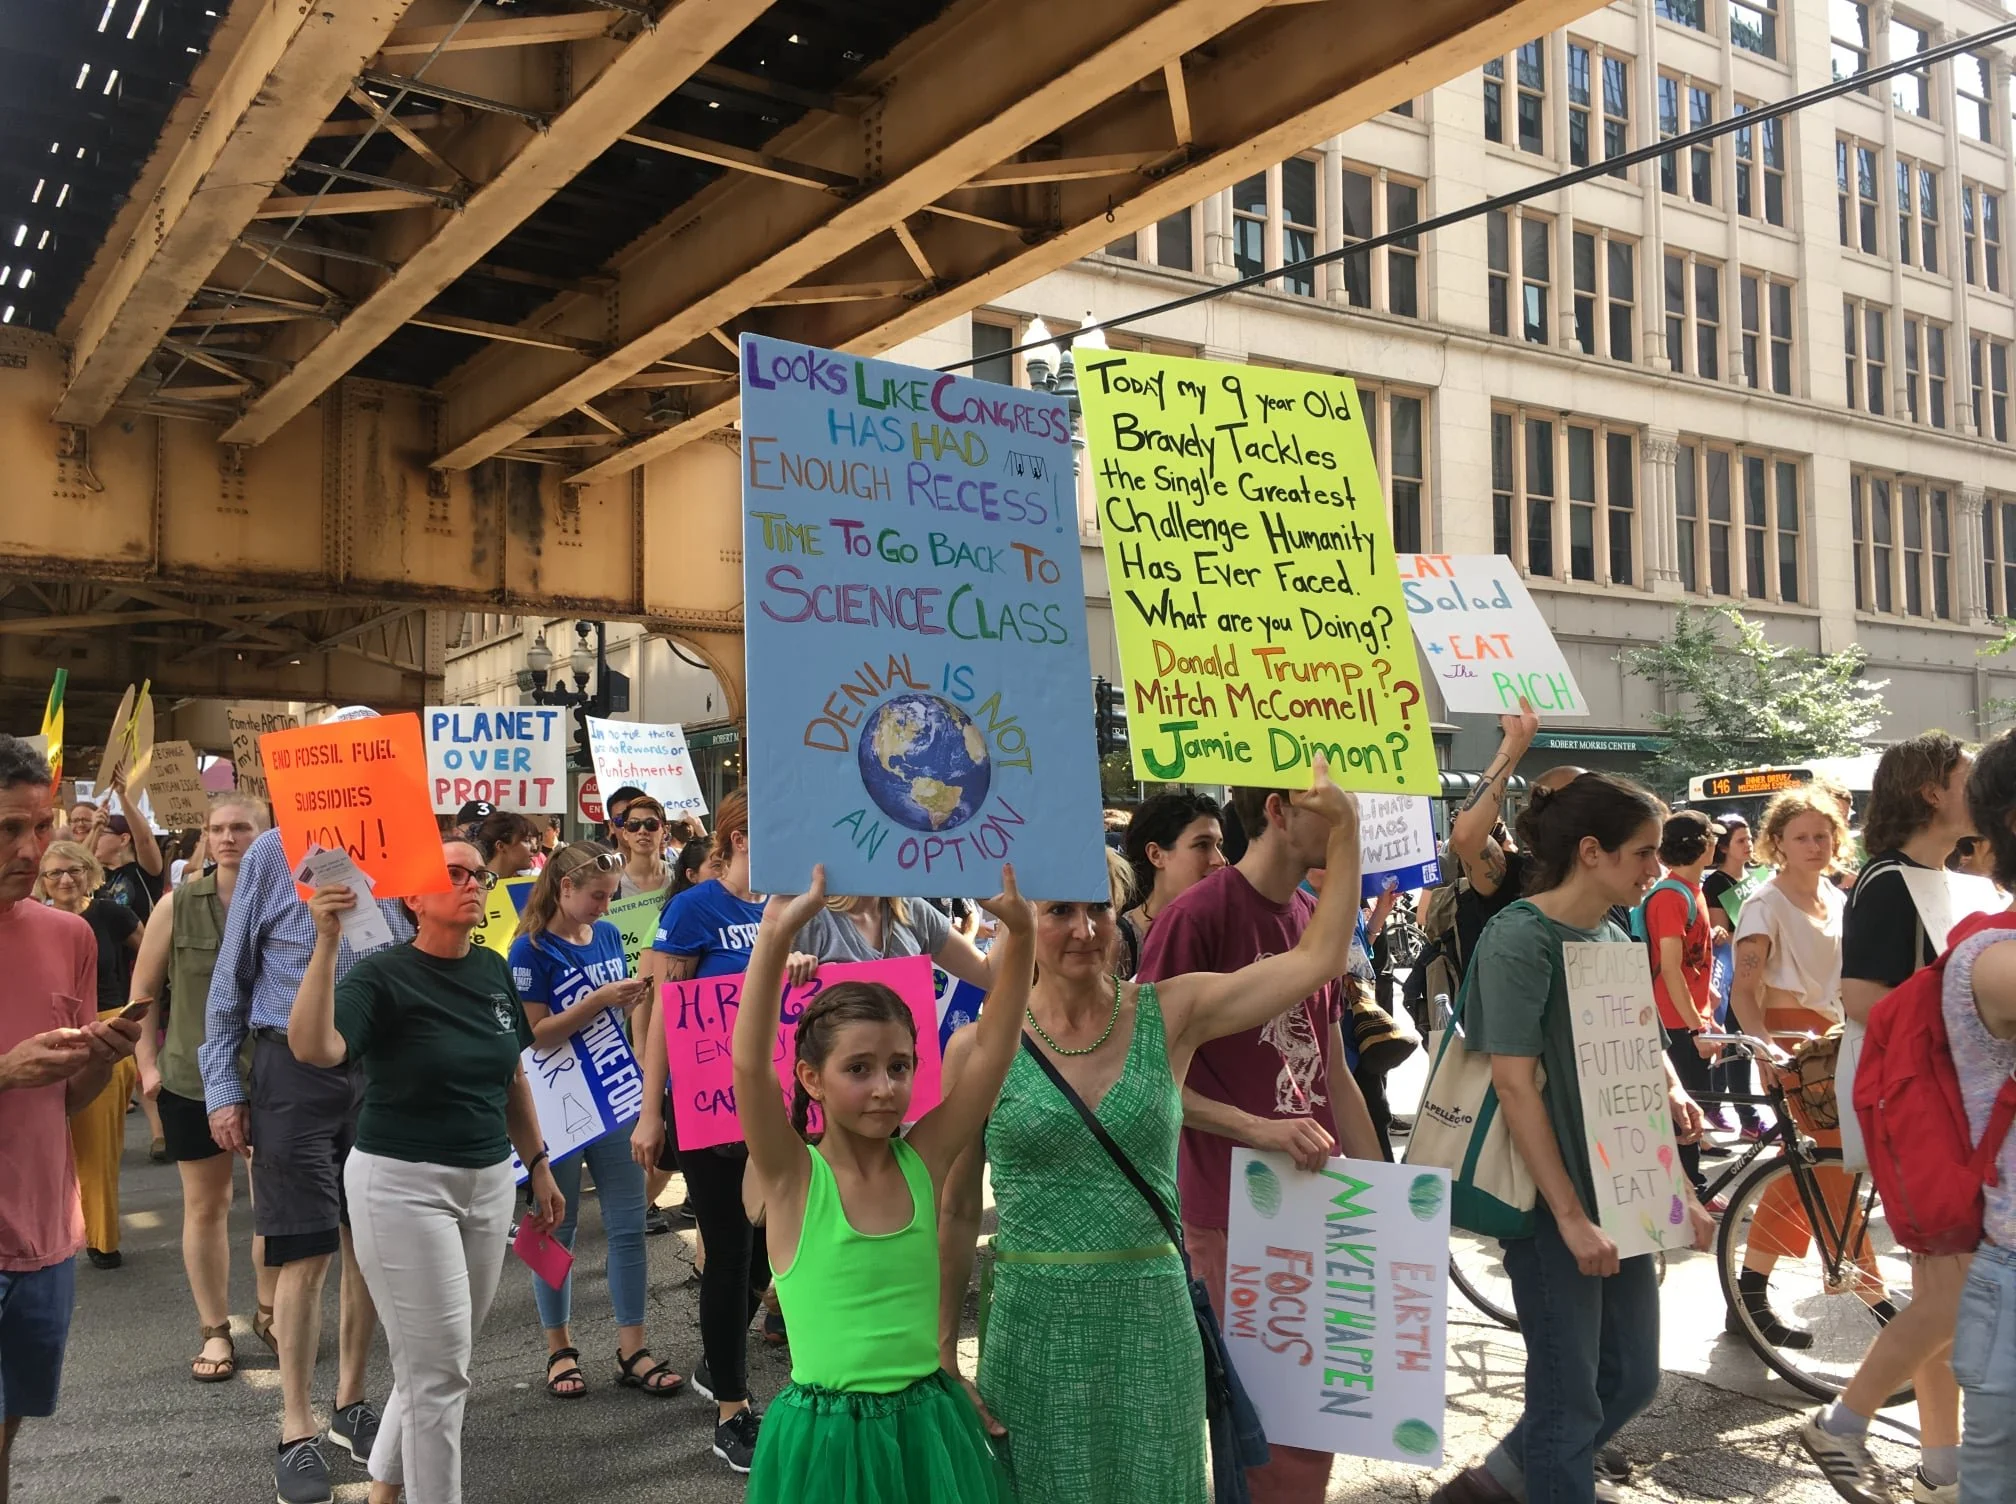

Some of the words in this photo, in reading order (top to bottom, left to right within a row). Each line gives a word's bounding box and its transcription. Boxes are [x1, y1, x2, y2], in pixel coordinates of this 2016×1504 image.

[747, 342, 848, 395] LOOKS
[855, 361, 930, 411] LIKE
[931, 375, 1069, 444] CONGRESS
[1178, 379, 1207, 414] my
[1222, 375, 1248, 420] 9
[1256, 393, 1296, 423] year
[1304, 390, 1351, 422] Old
[827, 408, 905, 452] HAS
[911, 423, 988, 466] HAD
[1113, 413, 1215, 477] Bravely
[1215, 422, 1337, 470] Tackles
[749, 437, 891, 501] ENOUGH
[1100, 459, 1146, 491] the
[1154, 465, 1228, 506] Single
[1238, 472, 1356, 510] Greatest
[750, 511, 824, 556] TIME
[829, 518, 872, 557] TO
[877, 528, 918, 564] GO
[929, 532, 1006, 574] BACK
[1010, 542, 1060, 584] TO
[1106, 496, 1250, 552] Challenge
[1260, 511, 1375, 576] Humanity
[1118, 541, 1181, 583] Has
[1194, 551, 1261, 587] Ever
[1274, 560, 1360, 596] Faced.
[760, 565, 946, 635] SCIENCE
[947, 583, 1068, 644] CLASS
[1402, 580, 1513, 614] Salad
[1125, 588, 1208, 630] What
[1217, 610, 1253, 632] are
[1263, 615, 1292, 643] you
[1300, 605, 1393, 655] Doing?
[1449, 634, 1516, 660] EAT
[943, 662, 975, 702] IS
[1152, 639, 1239, 679] Donald
[1252, 647, 1392, 698] Trump?
[1443, 663, 1478, 678] The
[803, 653, 931, 753] DENIAL
[1134, 679, 1216, 718] Mitch
[1226, 680, 1420, 731] McConnell?
[1492, 672, 1575, 711] RICH
[432, 711, 558, 743] PLANET
[974, 692, 1033, 775] NOT
[1550, 739, 1578, 749] ROBERT
[1579, 741, 1607, 750] MORRIS
[1608, 741, 1637, 751] CENTER
[272, 750, 291, 770] END
[295, 743, 343, 767] FOSSIL
[352, 739, 396, 763] FUEL
[444, 747, 532, 772] OVER
[598, 756, 683, 777] Punishments
[670, 746, 685, 756] or
[1142, 720, 1252, 780] Jamie
[1269, 727, 1409, 784] Dimon?
[295, 786, 373, 812] SUBSIDIES
[435, 778, 555, 807] PROFIT
[1712, 779, 1730, 795] 146
[477, 803, 490, 816] 3
[1360, 796, 1414, 820] LIMATE
[1361, 816, 1408, 840] HAOS
[832, 809, 889, 863] AN
[897, 796, 1025, 873] OPTION
[610, 903, 637, 914] WATER
[719, 927, 730, 950] I
[553, 973, 583, 996] I
[606, 957, 623, 981] FO
[1566, 945, 1649, 990] BECAUSE
[560, 984, 630, 1077] SRIKE
[1596, 995, 1635, 1026] THE
[1578, 1037, 1659, 1077] FUTURE
[601, 1068, 643, 1123] FOR
[1599, 1082, 1664, 1118] NEEDS
[1613, 1125, 1646, 1159] TO
[1612, 1168, 1658, 1206] EAT
[1229, 1263, 1261, 1339] NOW!
[1260, 1245, 1314, 1367] FOCUS
[1389, 1261, 1436, 1372] EARTH
